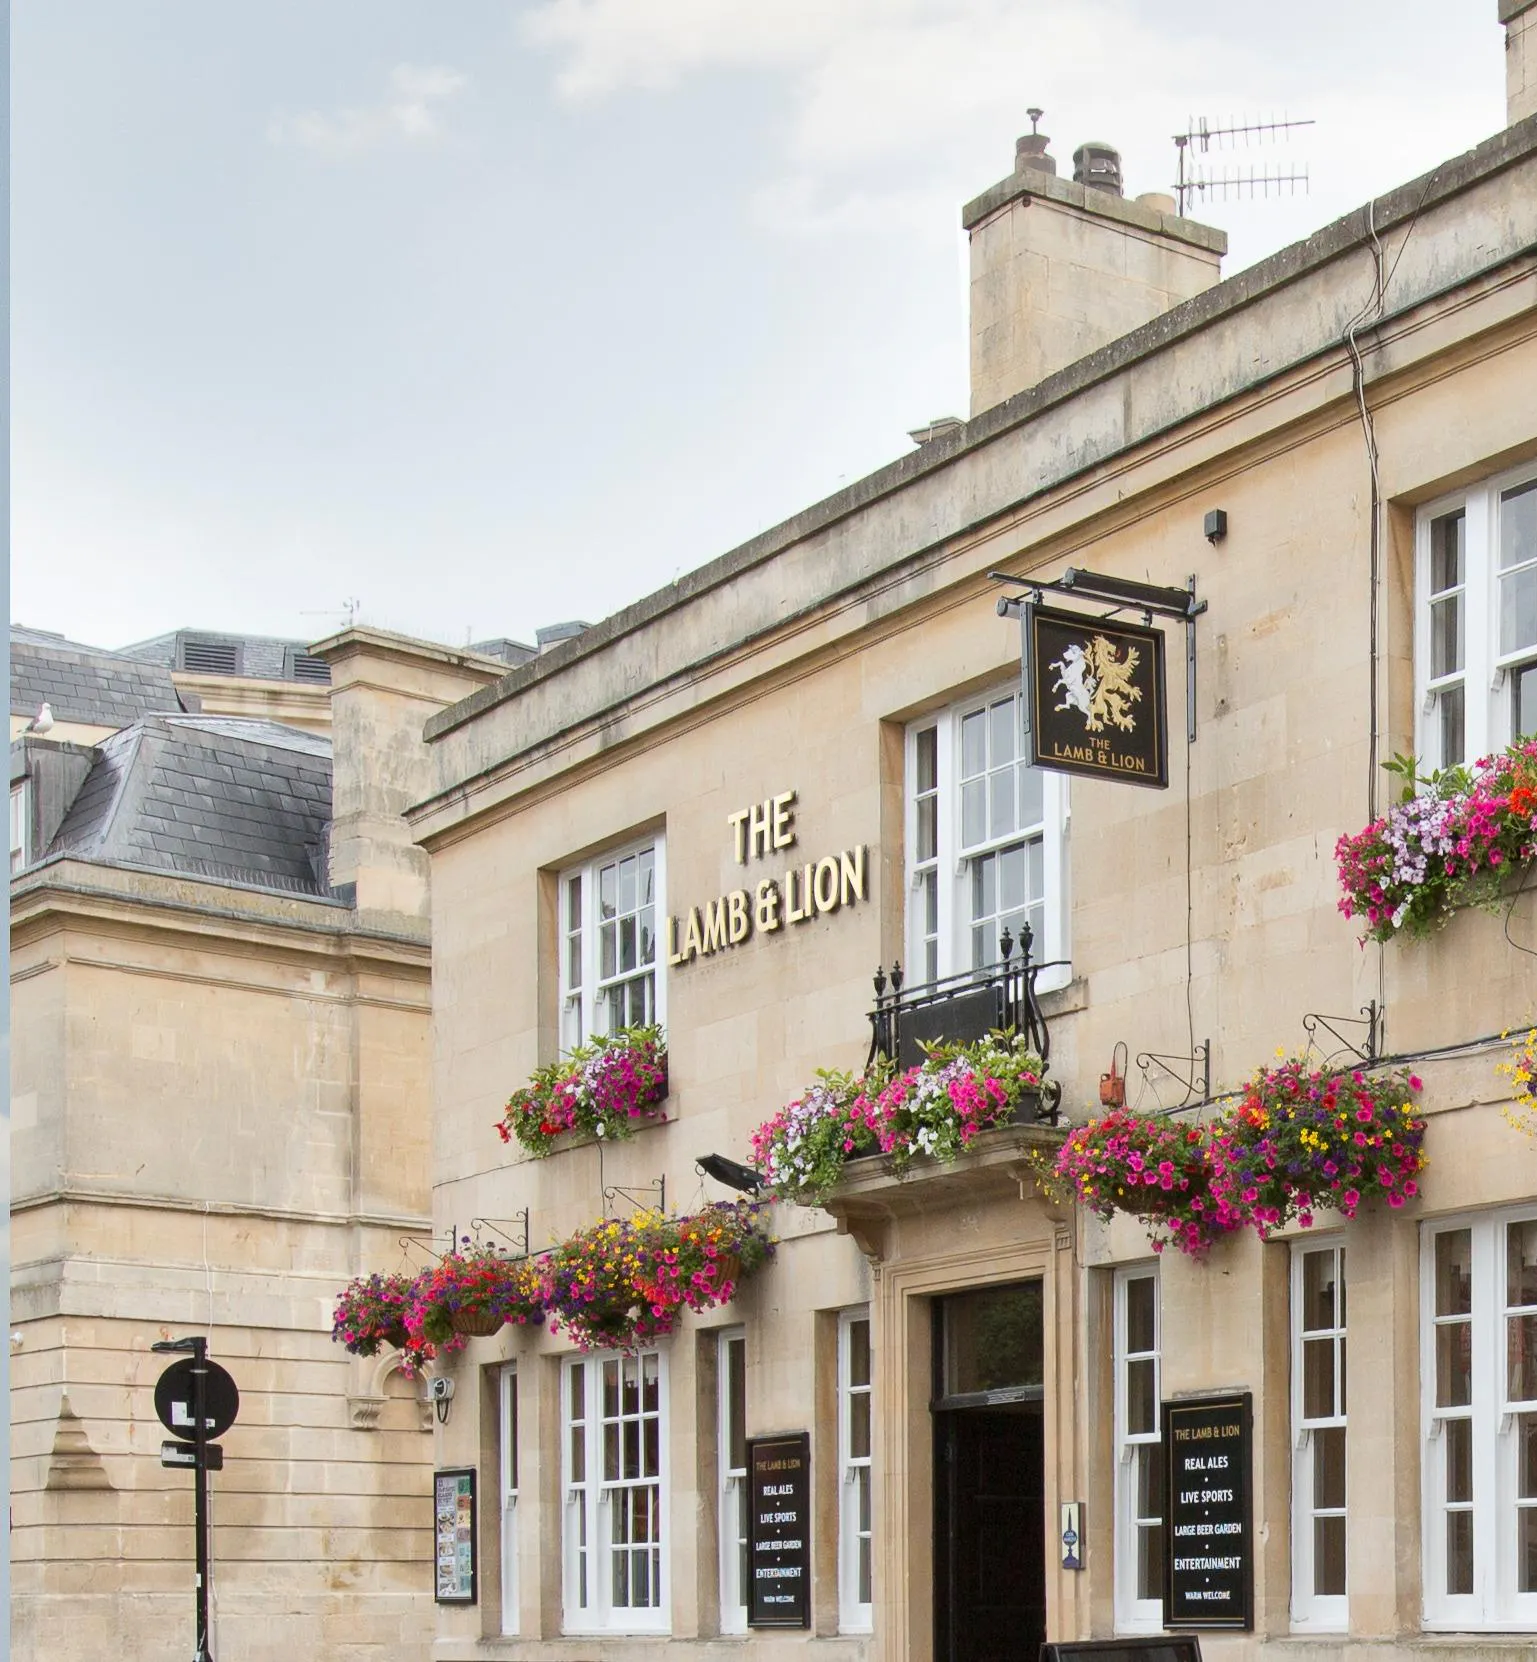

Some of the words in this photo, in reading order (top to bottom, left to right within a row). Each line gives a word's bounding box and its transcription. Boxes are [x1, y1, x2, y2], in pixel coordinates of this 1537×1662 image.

[1089, 736, 1112, 750] THE
[1054, 742, 1094, 763] LAMB
[1097, 750, 1108, 765] &
[1111, 753, 1145, 771] LION
[727, 789, 796, 865] THE
[666, 888, 750, 966] LAMB
[755, 878, 779, 933] &
[785, 844, 866, 924] LION
[1175, 1428, 1190, 1440] THE
[1192, 1426, 1212, 1439] LAMB
[1213, 1426, 1219, 1437] &
[1221, 1425, 1240, 1437] LION
[1184, 1457, 1206, 1470] REAL
[1207, 1456, 1229, 1469] ALES
[763, 1485, 778, 1496] REAL
[778, 1484, 793, 1495] ALES
[1180, 1491, 1199, 1504] LIVE
[1201, 1489, 1233, 1503] SPORTS
[760, 1512, 773, 1523] LIVE
[774, 1511, 797, 1522] SPORTS
[1174, 1524, 1196, 1536] LARGE
[1196, 1524, 1214, 1535] BEER
[1214, 1522, 1242, 1534] GARDEN
[1174, 1556, 1242, 1570] ENTERTAINMENT
[1184, 1591, 1202, 1600] WARM
[1202, 1590, 1231, 1600] WELCOME
